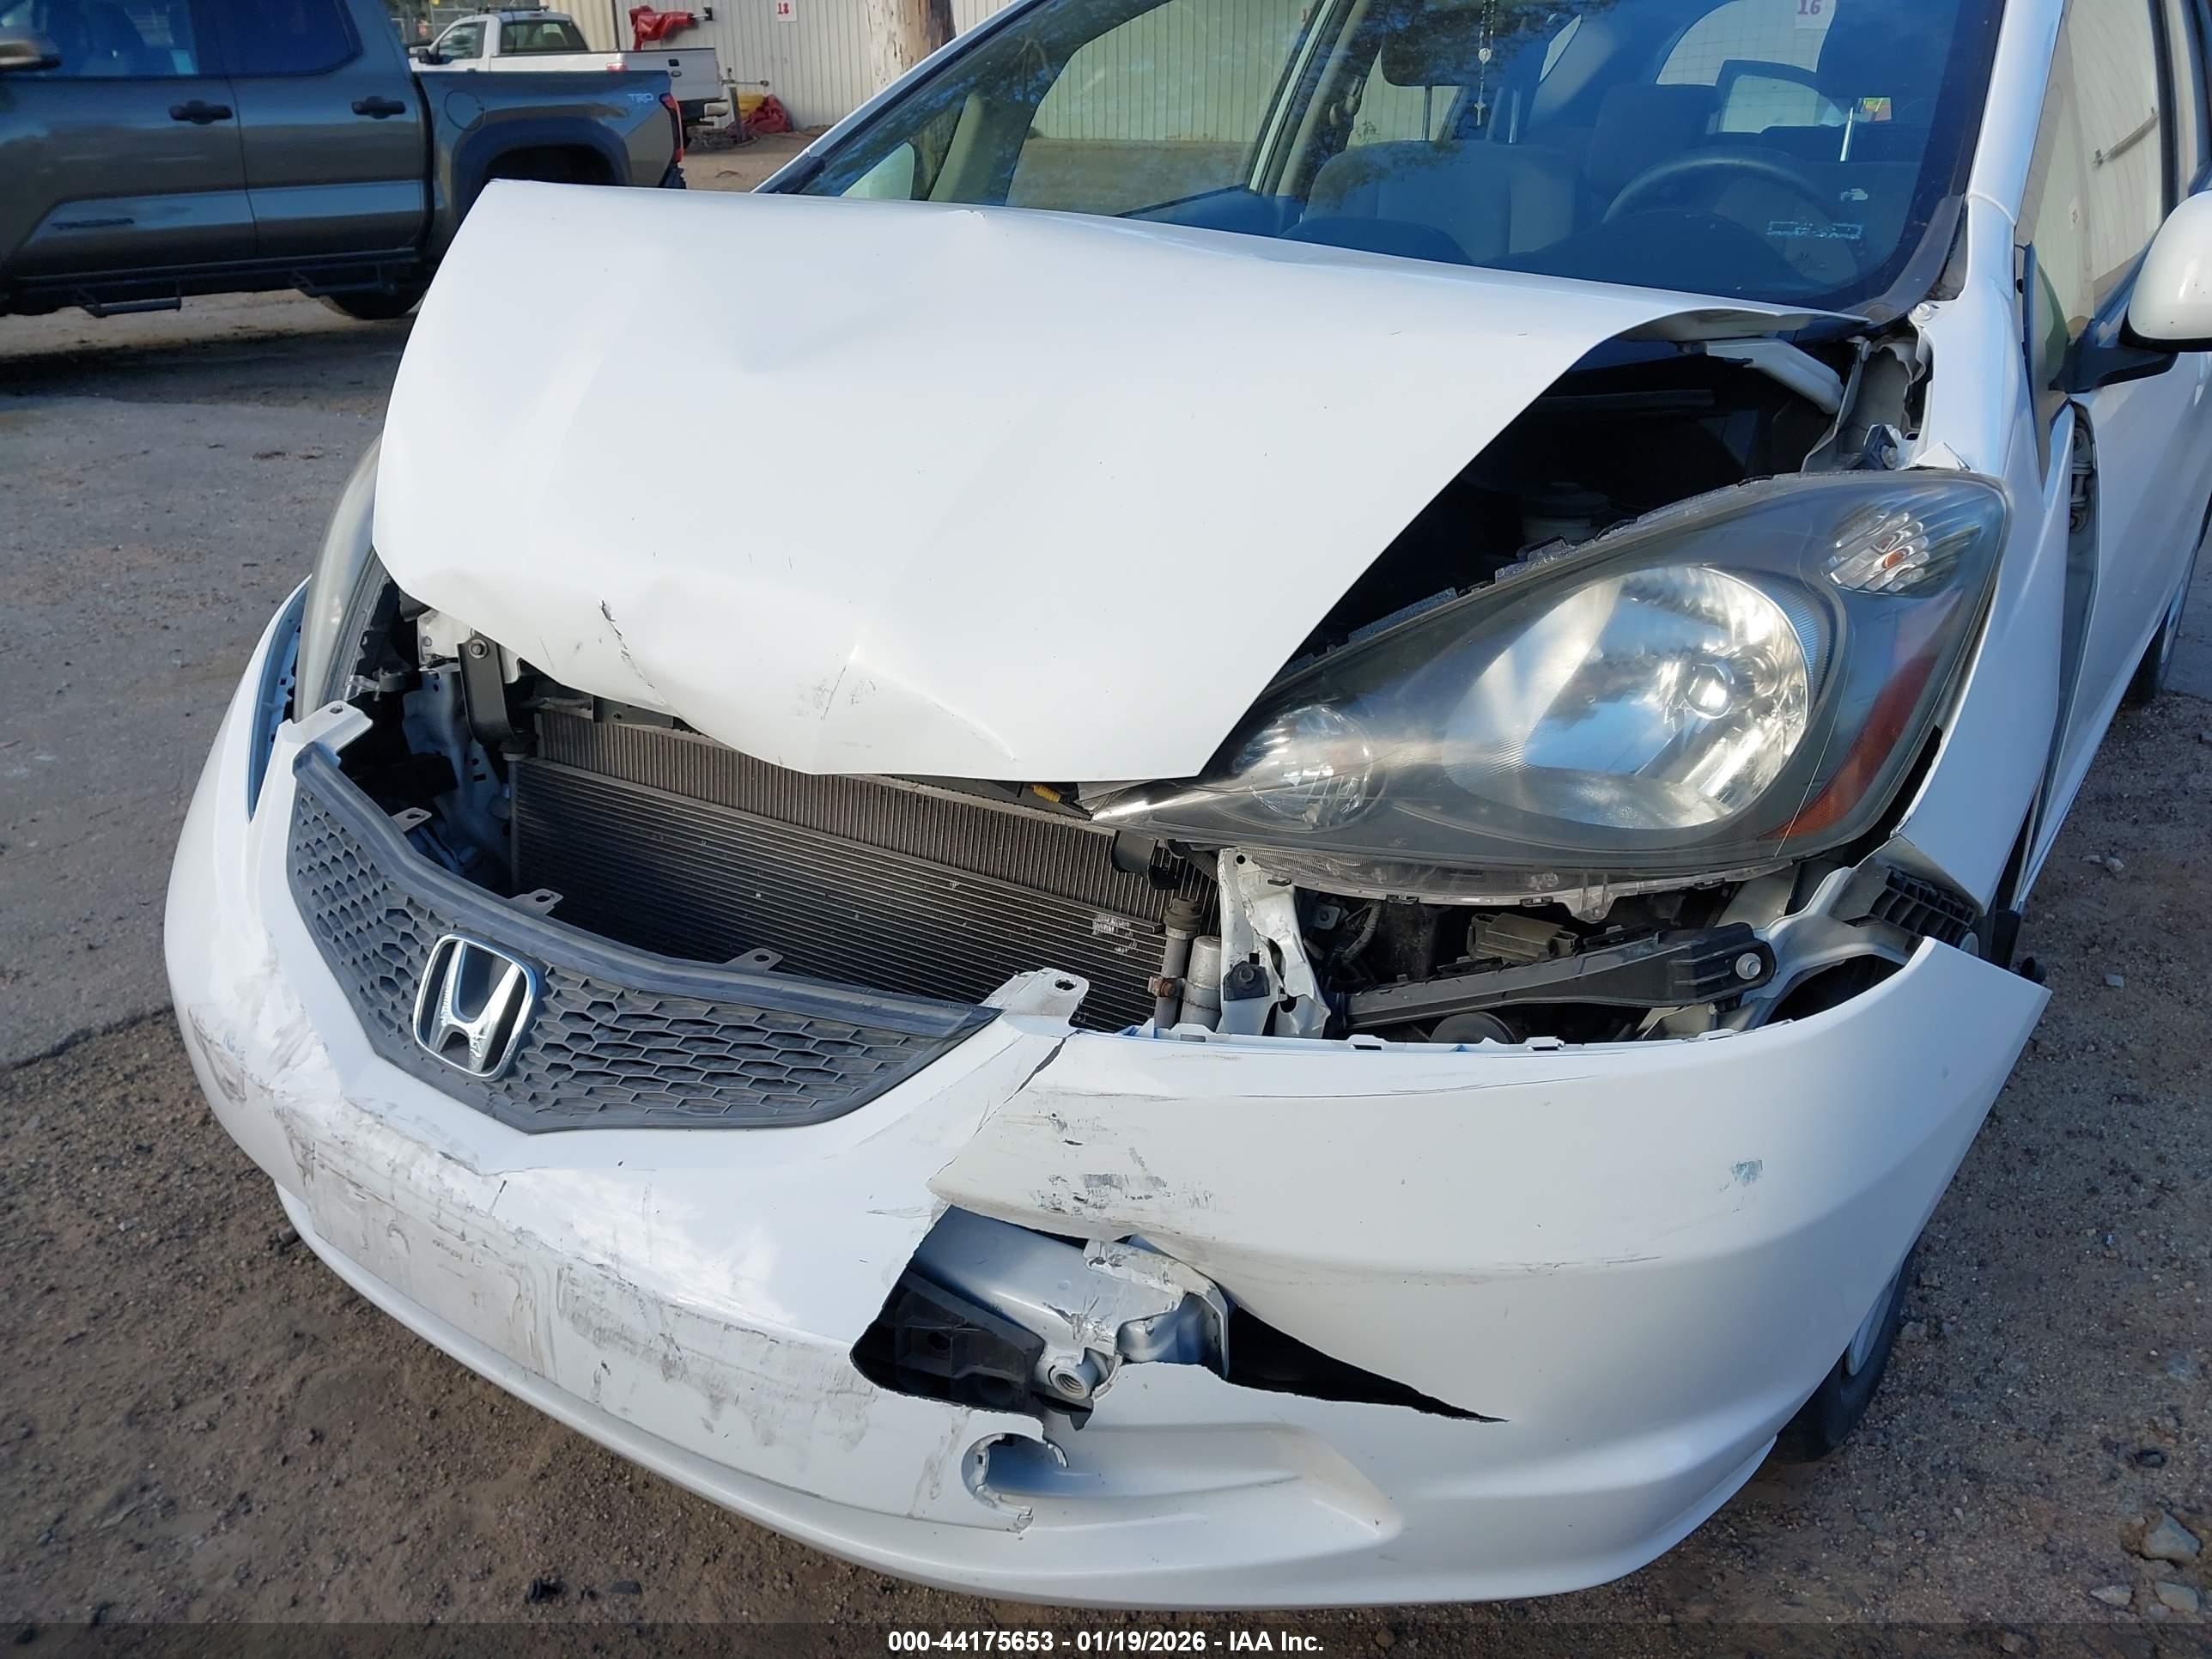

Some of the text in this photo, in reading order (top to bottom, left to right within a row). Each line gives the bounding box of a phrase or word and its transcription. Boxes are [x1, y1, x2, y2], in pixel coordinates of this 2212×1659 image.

[777, 2, 790, 15] 18
[1796, 0, 1821, 15] 16
[627, 93, 654, 104] TRD
